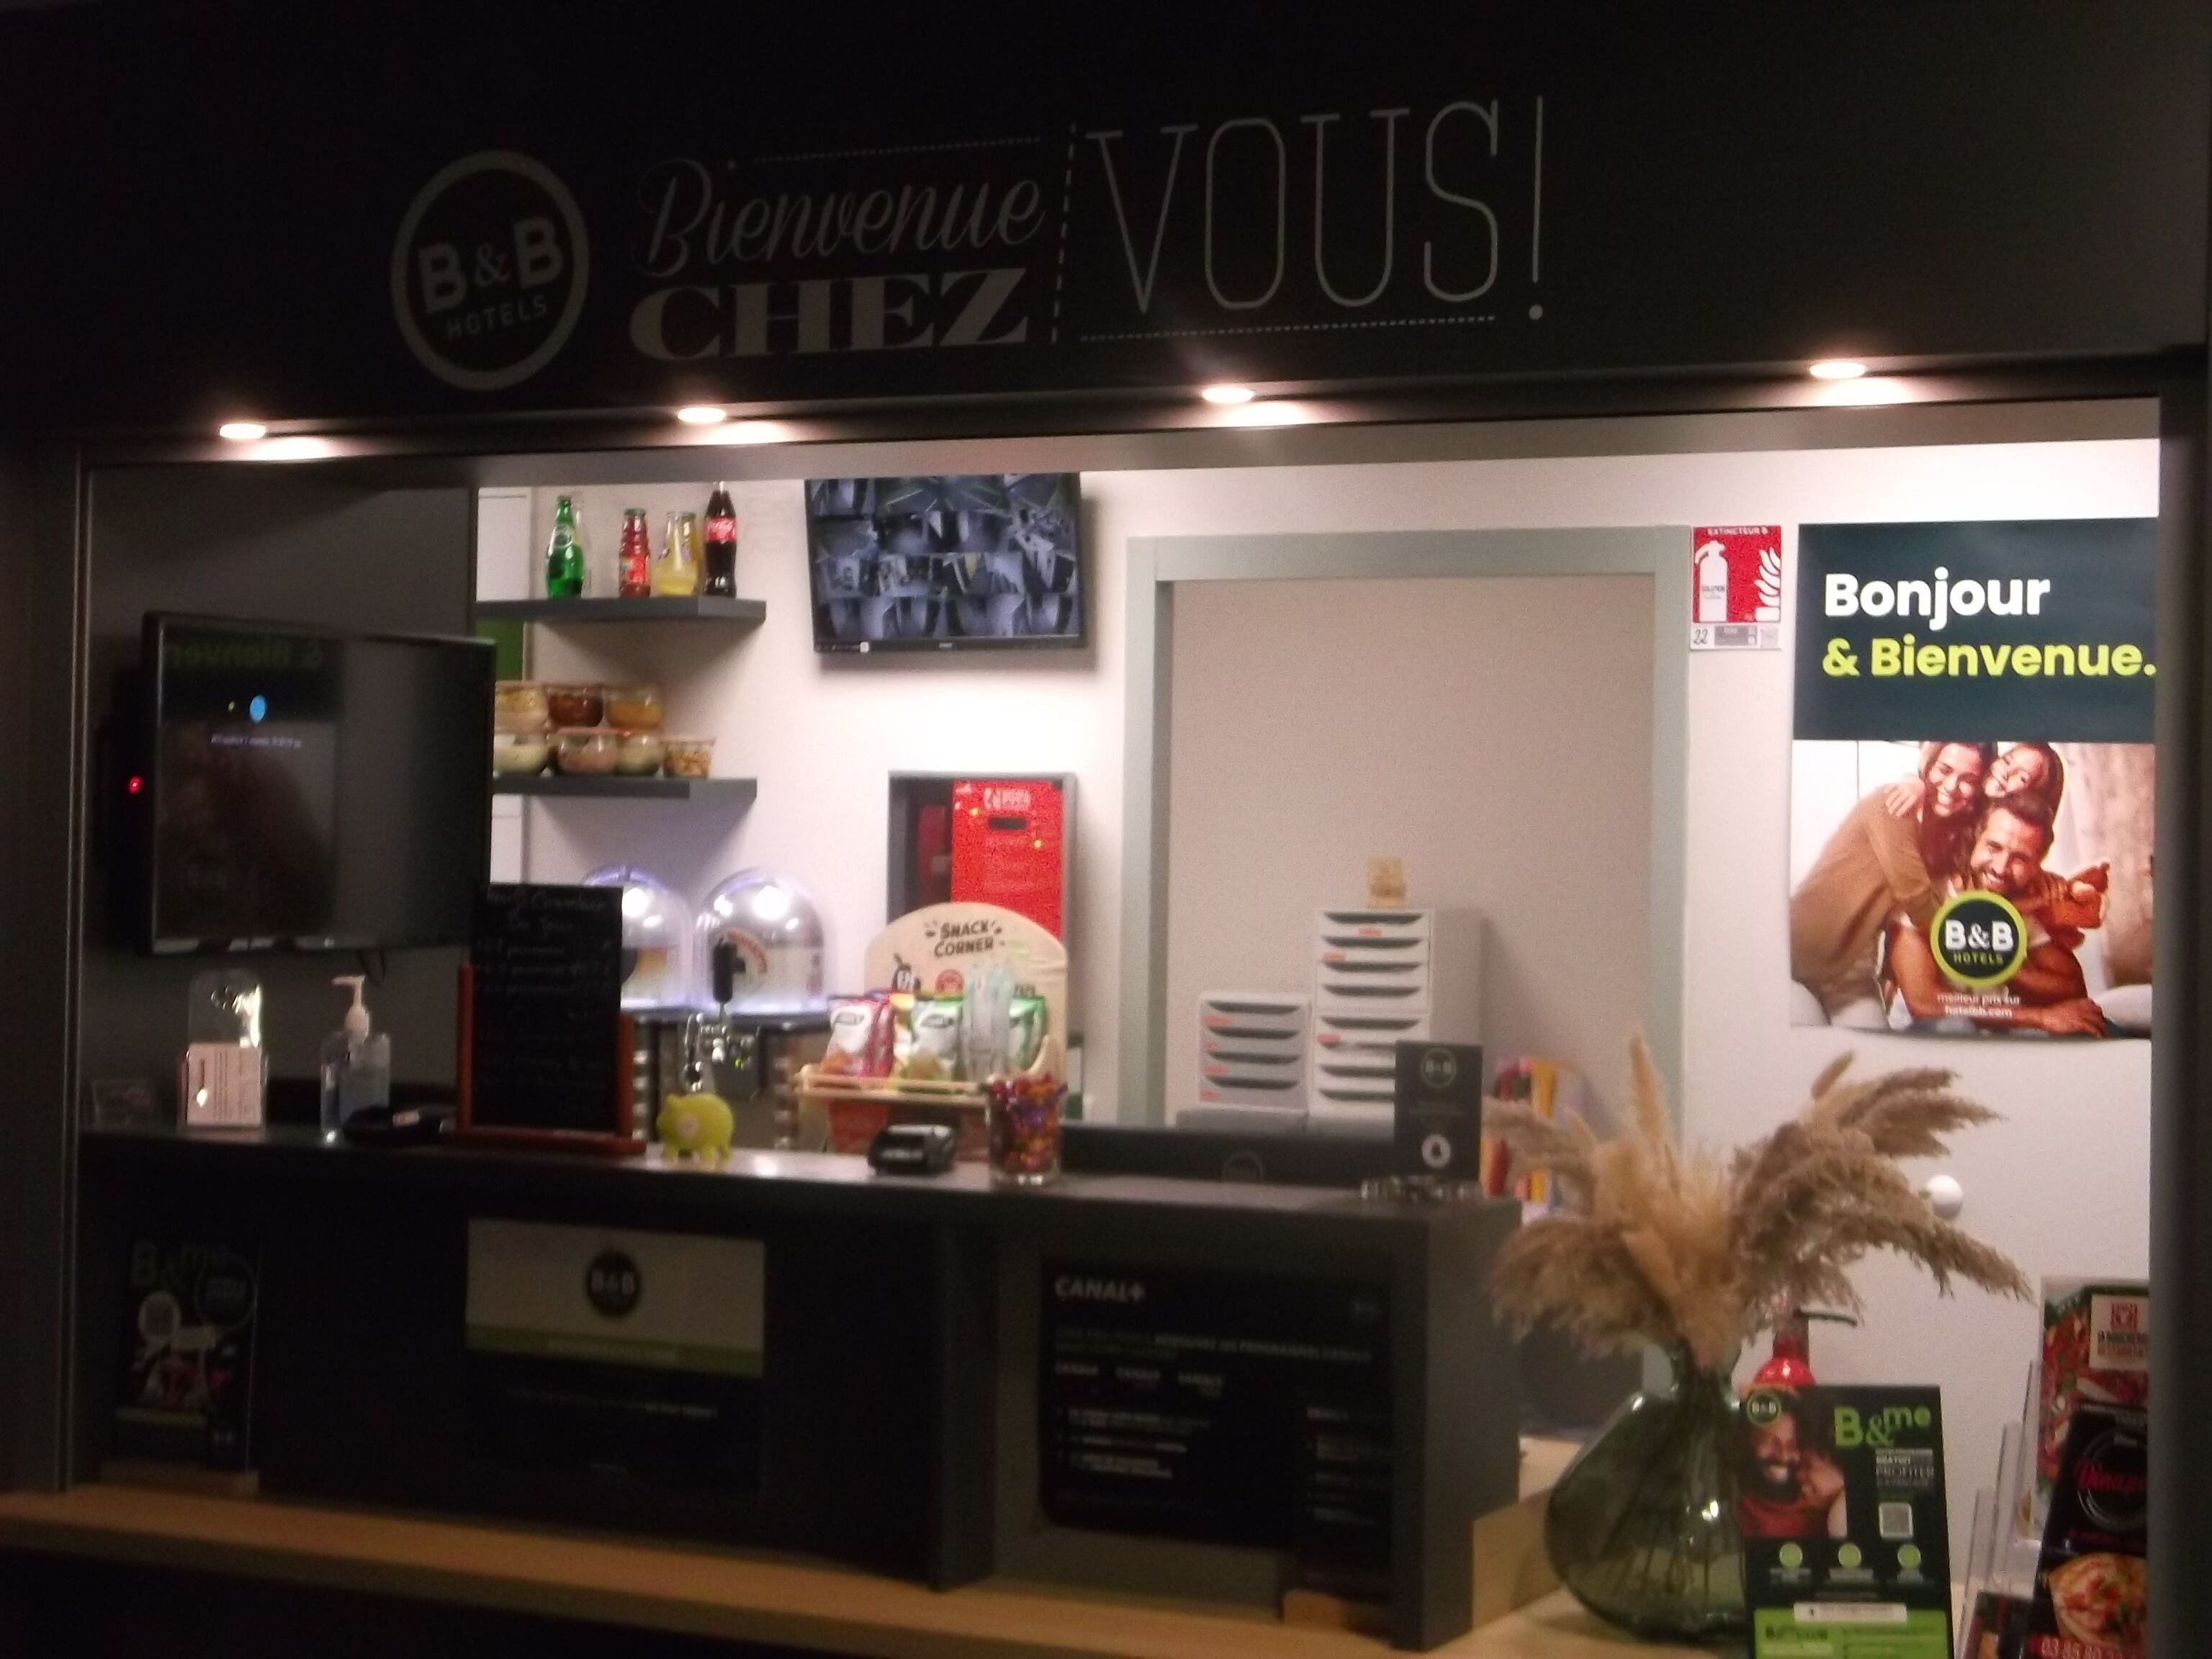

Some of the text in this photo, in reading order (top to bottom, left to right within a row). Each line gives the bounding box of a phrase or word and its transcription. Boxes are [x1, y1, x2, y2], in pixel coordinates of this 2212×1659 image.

[631, 156, 1046, 278] Bienvenue
[418, 217, 565, 314] B&B
[446, 294, 548, 339] HOTELS
[628, 267, 1029, 361] CHEZ
[1824, 566, 2051, 631] Bonjour
[1822, 633, 2157, 677] & Bienvenue.
[934, 937, 994, 958] CORNER
[940, 920, 989, 939] SNACK
[1945, 919, 2014, 951] B&B
[1953, 951, 2004, 964] HOTELS
[1053, 1275, 1147, 1304] CANAL+
